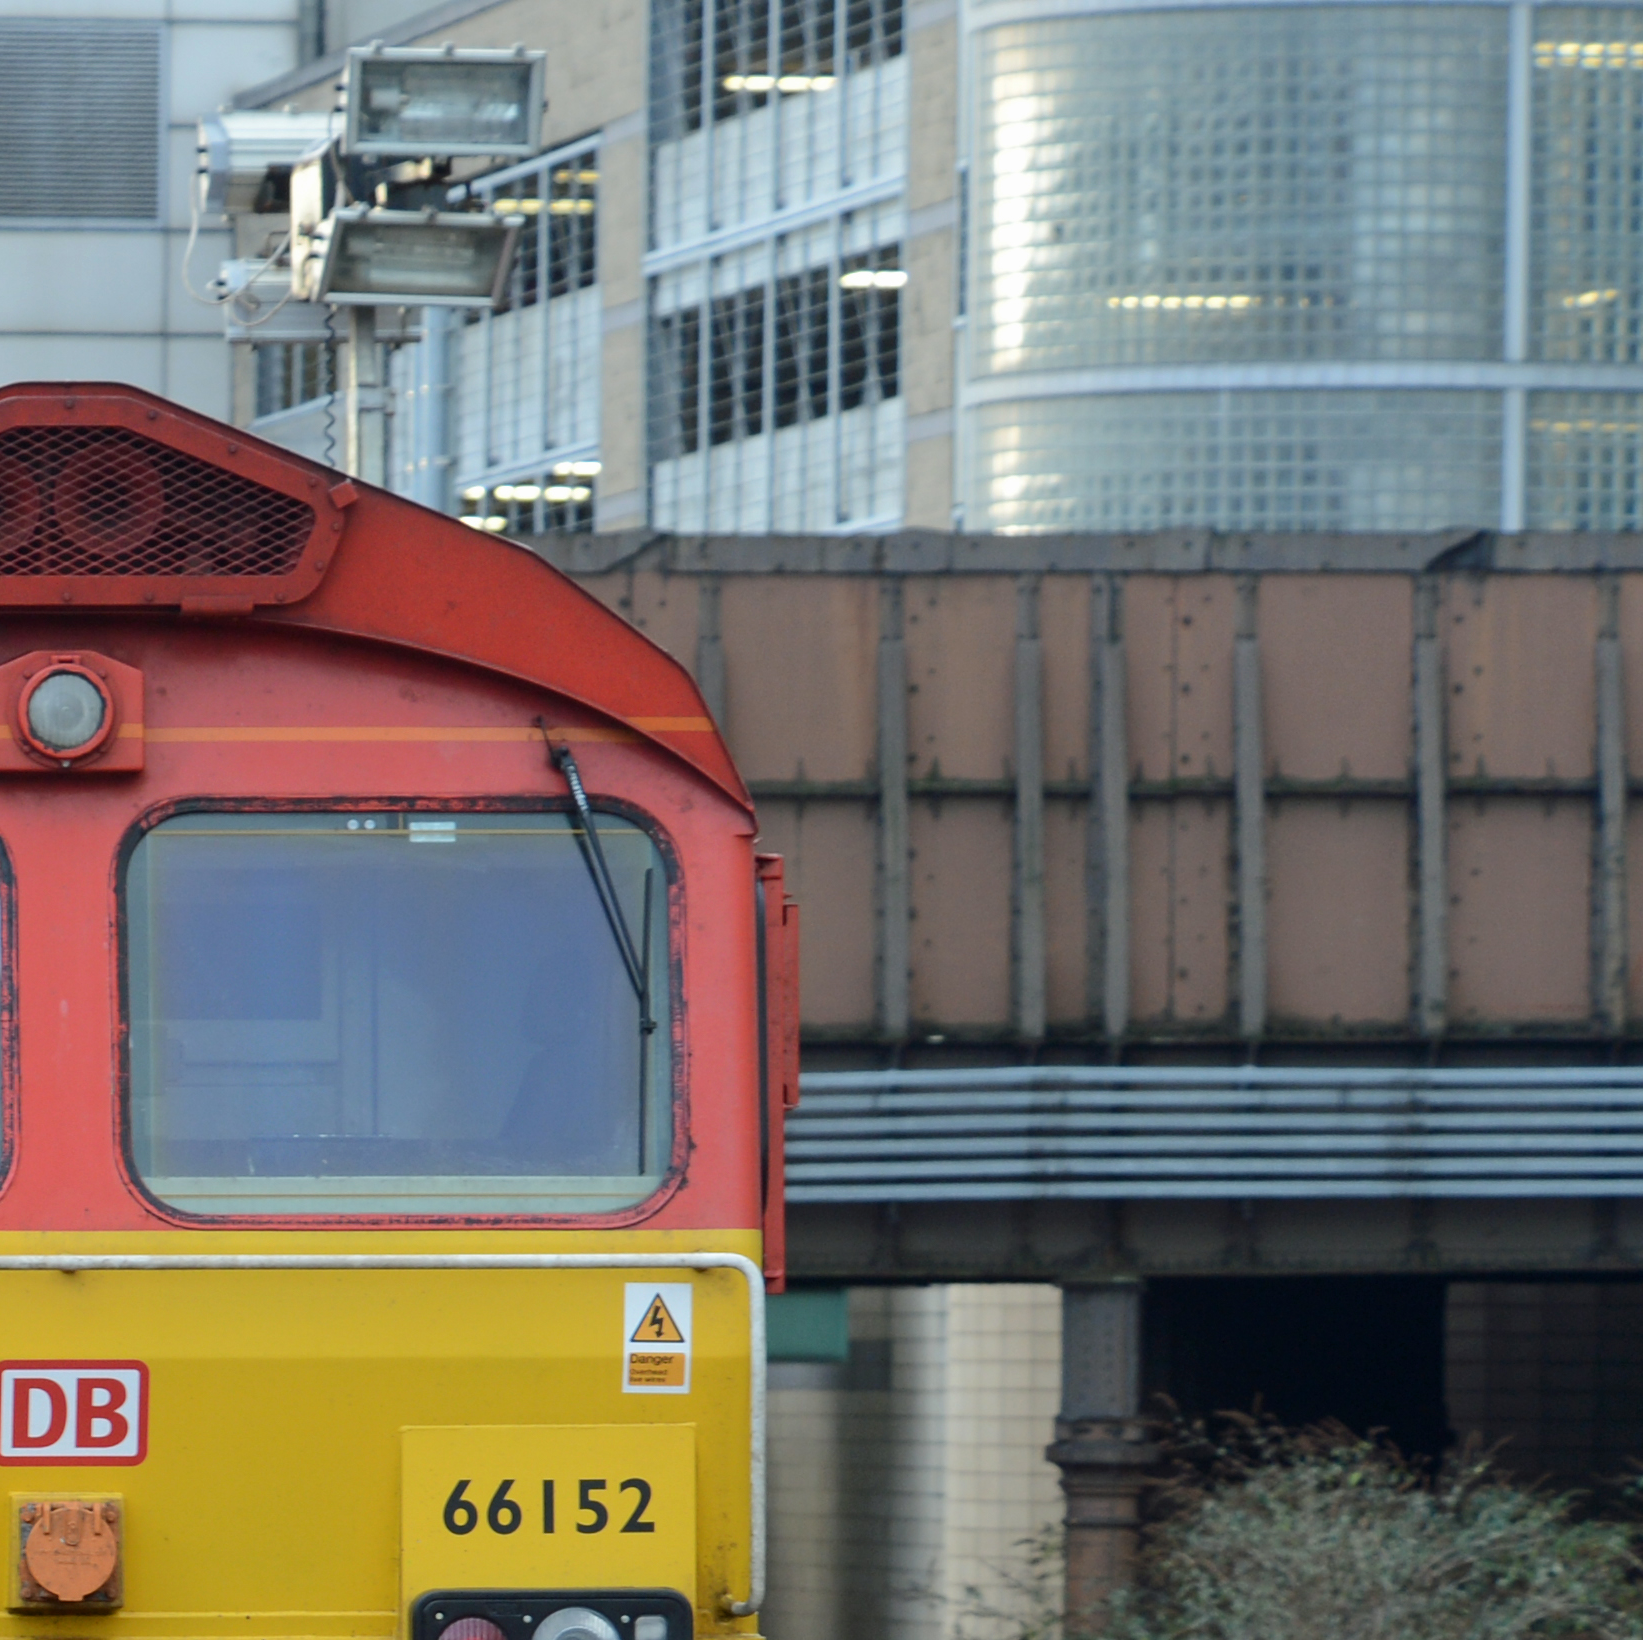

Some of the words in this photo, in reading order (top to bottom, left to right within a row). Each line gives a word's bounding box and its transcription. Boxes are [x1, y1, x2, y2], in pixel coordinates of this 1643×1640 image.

[630, 1353, 674, 1366] Danger
[11, 1377, 129, 1449] DB
[443, 1477, 656, 1535] 66152
